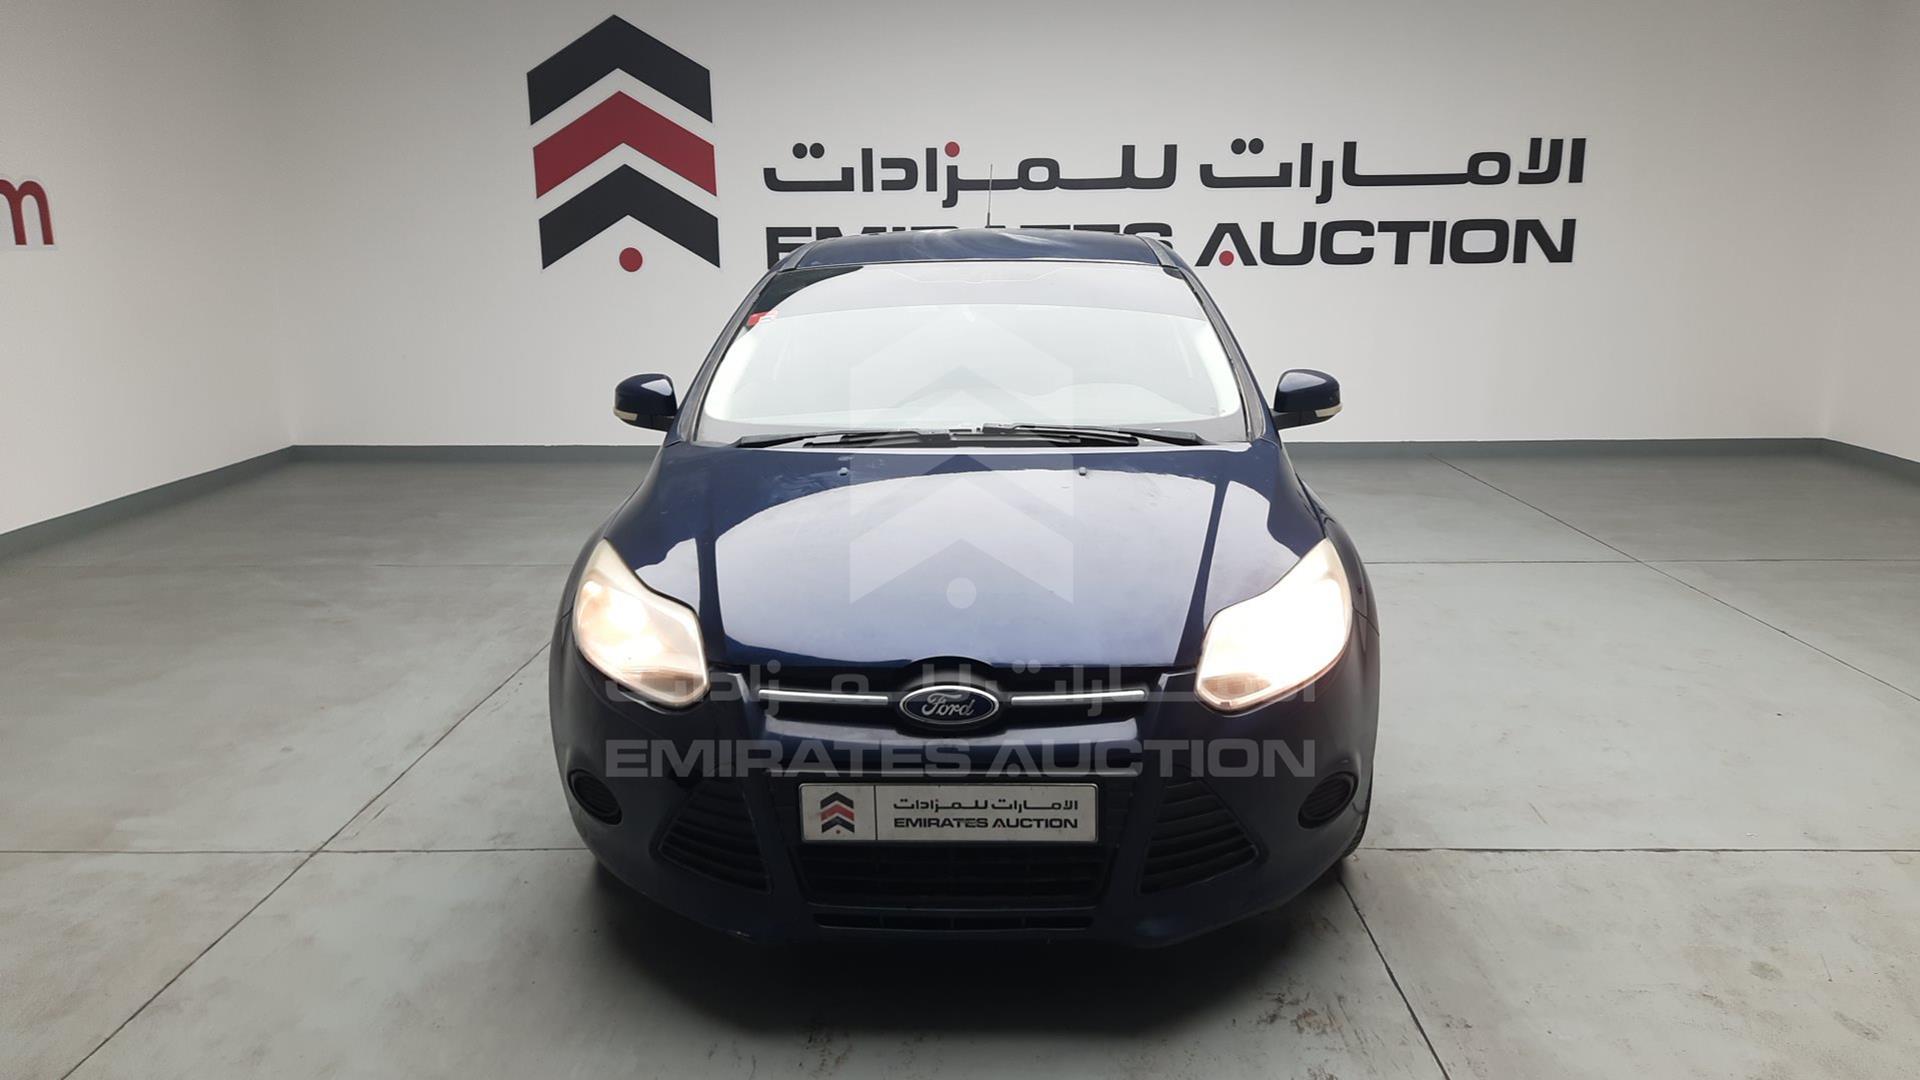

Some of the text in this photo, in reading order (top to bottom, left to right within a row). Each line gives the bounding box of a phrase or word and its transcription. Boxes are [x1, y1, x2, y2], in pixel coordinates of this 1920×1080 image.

[763, 138, 1586, 208] الامارات للمزادات
[1195, 219, 1576, 267] AUCTION
[922, 692, 975, 716] Ford
[894, 818, 1078, 828] EMIRATES AUCTION
